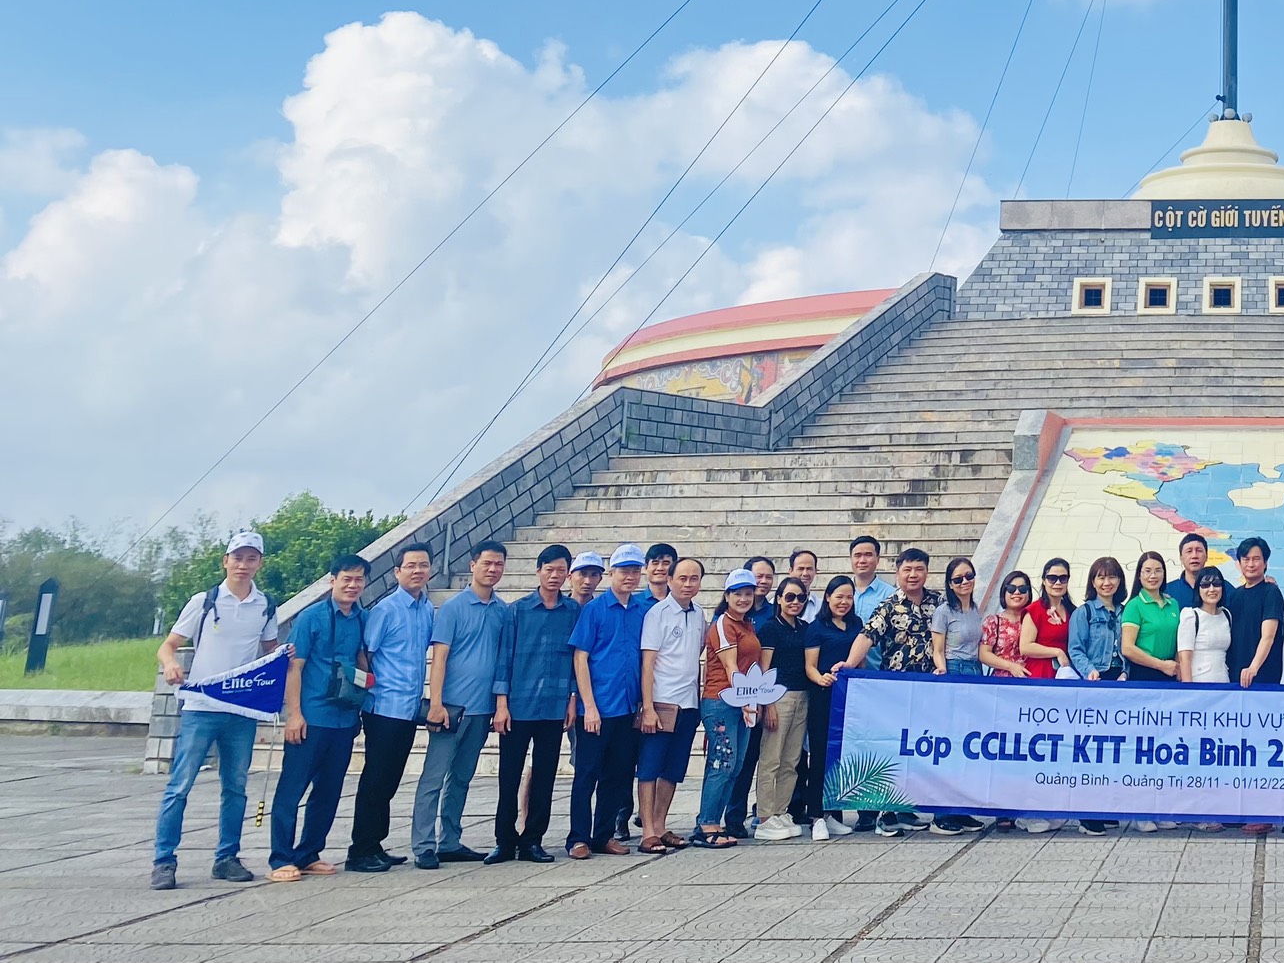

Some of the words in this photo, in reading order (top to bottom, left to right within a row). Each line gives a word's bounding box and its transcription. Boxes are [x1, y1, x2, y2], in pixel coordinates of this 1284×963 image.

[1153, 205, 1184, 232] CỘT
[1187, 205, 1208, 228] CỜ
[221, 677, 254, 689] Elite
[253, 674, 277, 687] Tour
[736, 686, 758, 696] Elite
[1018, 707, 1060, 728] HỌC
[1065, 707, 1108, 728] VIỆN
[1114, 707, 1173, 727] CHÍNH
[1178, 710, 1208, 730] TRỊ
[1213, 711, 1252, 729] KHU
[899, 728, 952, 766] Lớp
[962, 731, 1064, 762] CCLLCT
[1072, 734, 1127, 765] KTT
[1134, 735, 1190, 766] Hoà
[1199, 737, 1257, 767] Bình
[1035, 772, 1077, 788] Quảng
[1081, 772, 1110, 787] Bình
[1121, 774, 1164, 790] Quảng
[1168, 775, 1184, 791] Trị
[1187, 776, 1220, 790] 28/11
